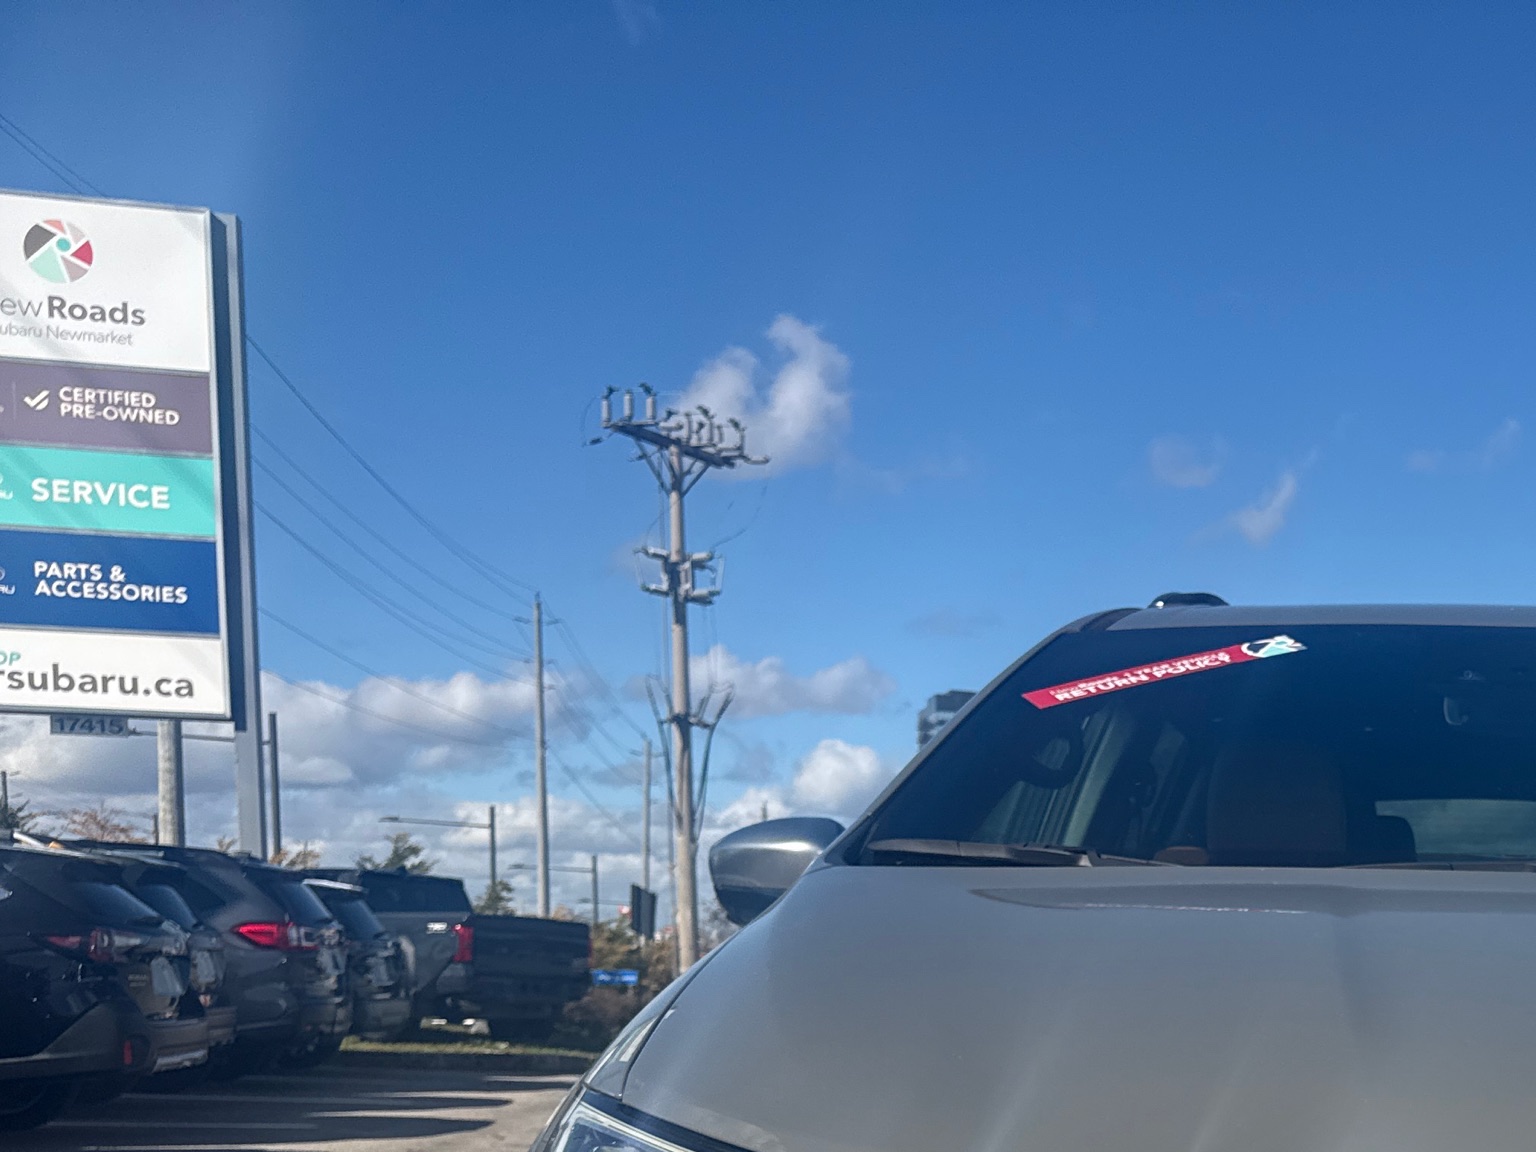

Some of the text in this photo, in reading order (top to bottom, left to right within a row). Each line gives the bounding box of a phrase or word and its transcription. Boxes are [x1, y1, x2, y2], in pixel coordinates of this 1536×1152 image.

[46, 325, 134, 346] Newmarket
[58, 386, 156, 408] CERTIFIED
[59, 405, 180, 426] PRE-OWNED
[31, 477, 171, 510] SERVICE
[34, 560, 126, 583] PARTS &
[34, 580, 188, 604] ACCESSORIES
[1055, 652, 1232, 702] RETURN POLICY
[55, 717, 124, 735] 17415
